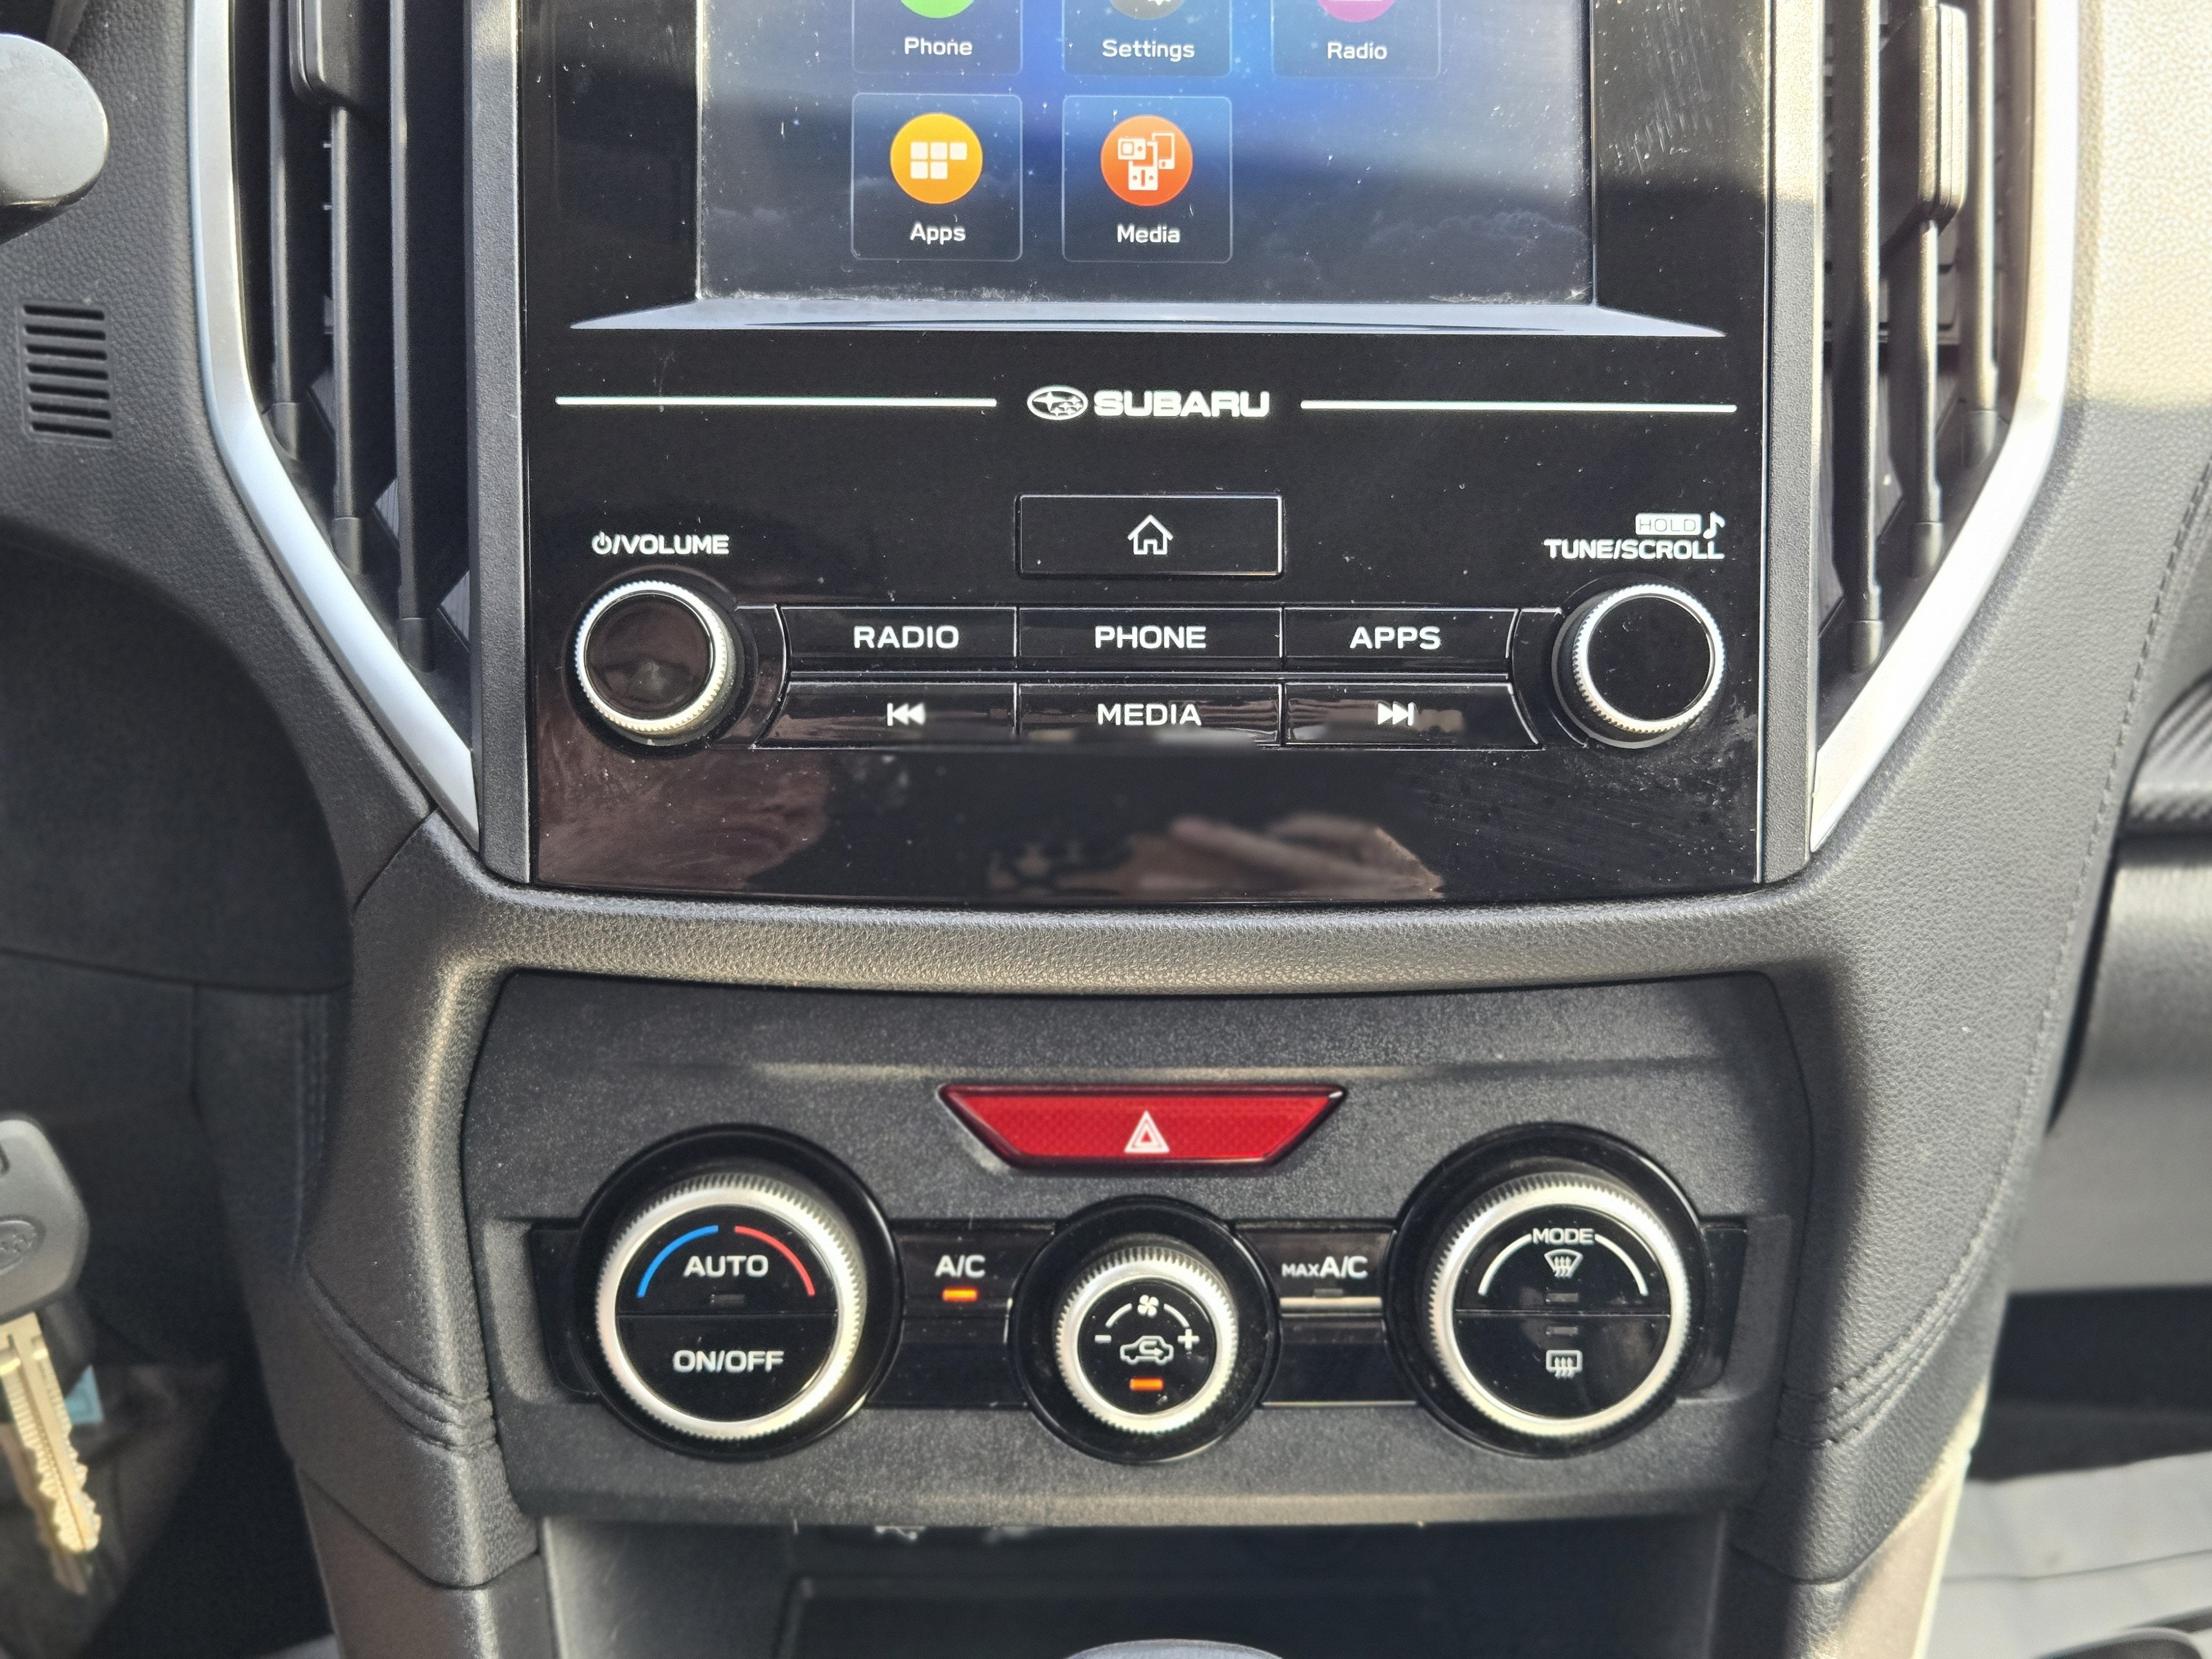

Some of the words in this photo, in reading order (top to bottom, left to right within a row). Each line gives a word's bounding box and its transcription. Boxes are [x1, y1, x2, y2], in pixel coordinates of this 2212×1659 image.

[904, 36, 973, 57] Phone
[1102, 39, 1196, 61] Settings
[1327, 41, 1388, 61] Radio
[910, 222, 966, 243] Apps
[1117, 225, 1181, 244] Media
[1093, 390, 1270, 418] SUBARU
[1639, 519, 1697, 533] HOLD
[1543, 539, 1725, 560] TUNE/SCROLL
[853, 625, 959, 649] RADIO
[1095, 626, 1207, 649] PHONE
[1349, 627, 1441, 649] APPS
[1097, 703, 1202, 726] MEDIA
[1532, 1228, 1594, 1244] MODE
[683, 1255, 769, 1277] AUTO
[935, 1254, 986, 1278] A/C
[672, 1350, 784, 1373] ON/OFF
